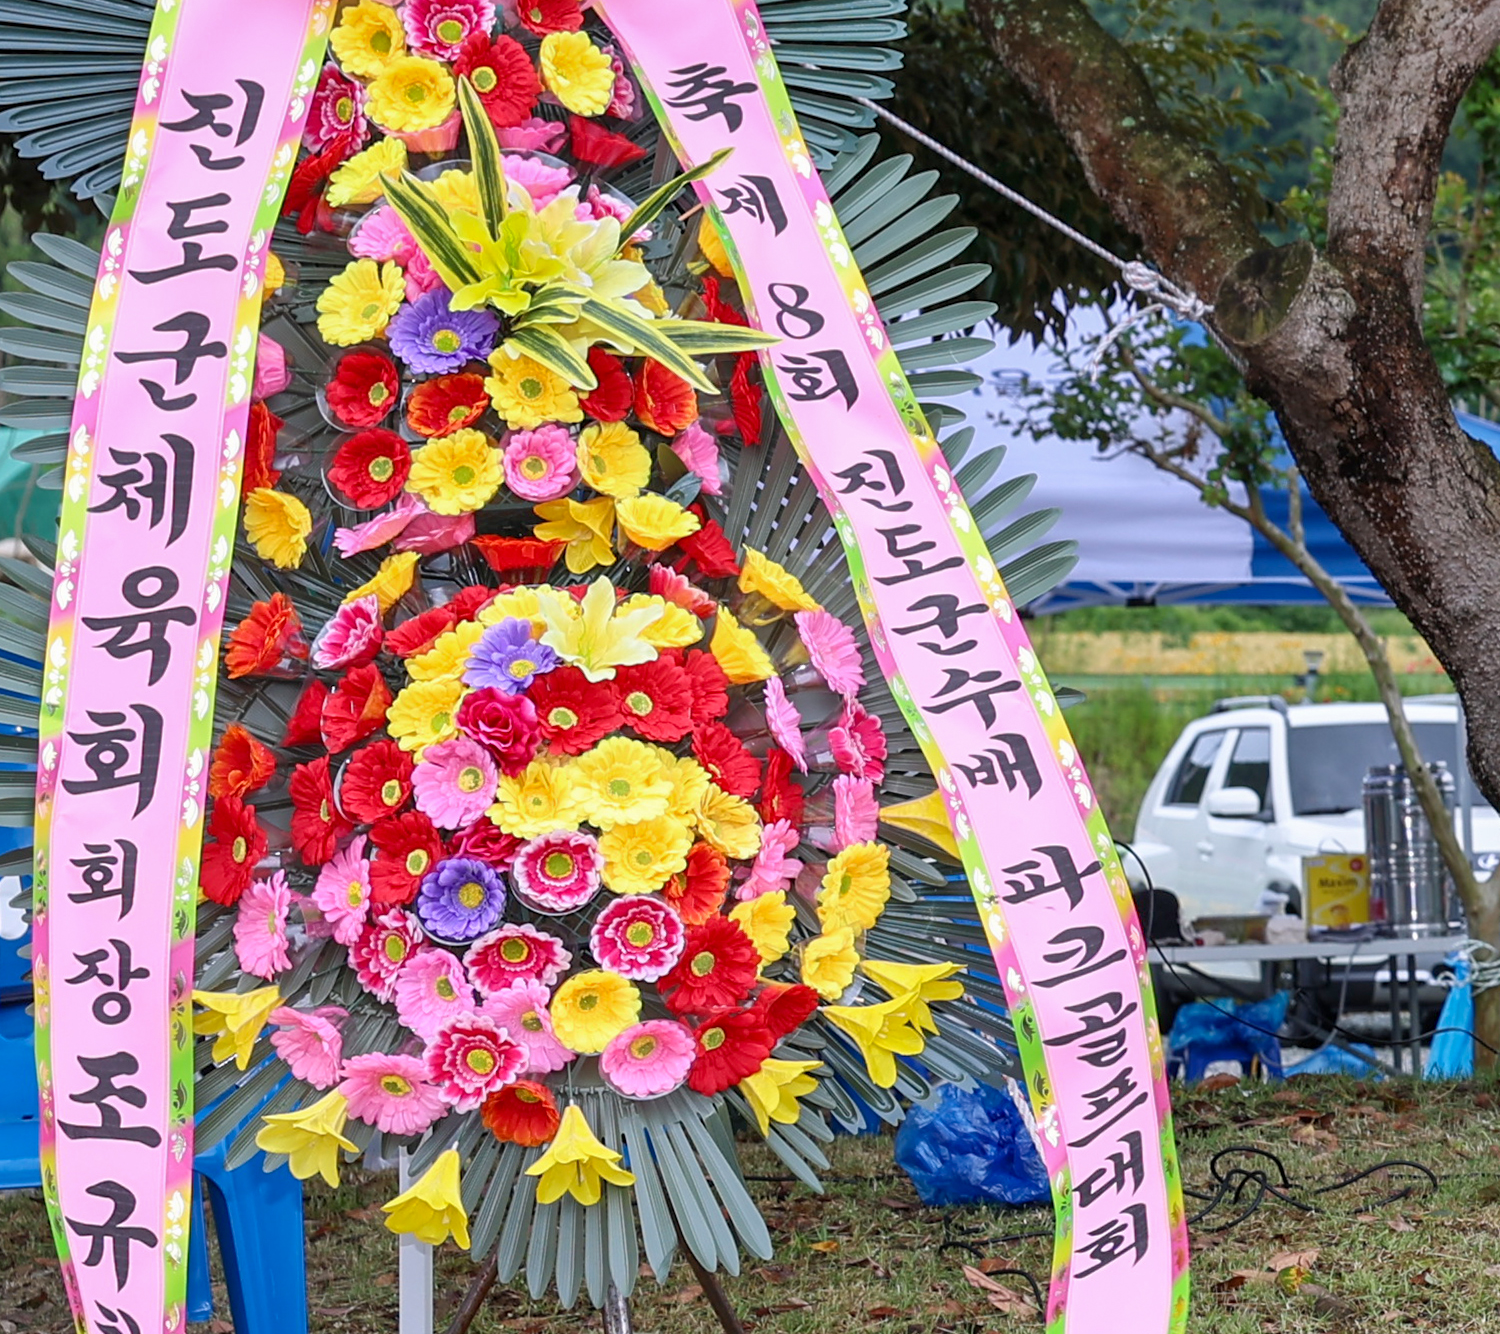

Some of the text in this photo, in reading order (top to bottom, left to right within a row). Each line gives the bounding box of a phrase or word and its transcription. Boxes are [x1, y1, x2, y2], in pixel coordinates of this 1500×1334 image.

[664, 63, 757, 134] 축
[833, 449, 1042, 800] 진도군수배
[1000, 845, 1150, 1280] 파크골프대회
